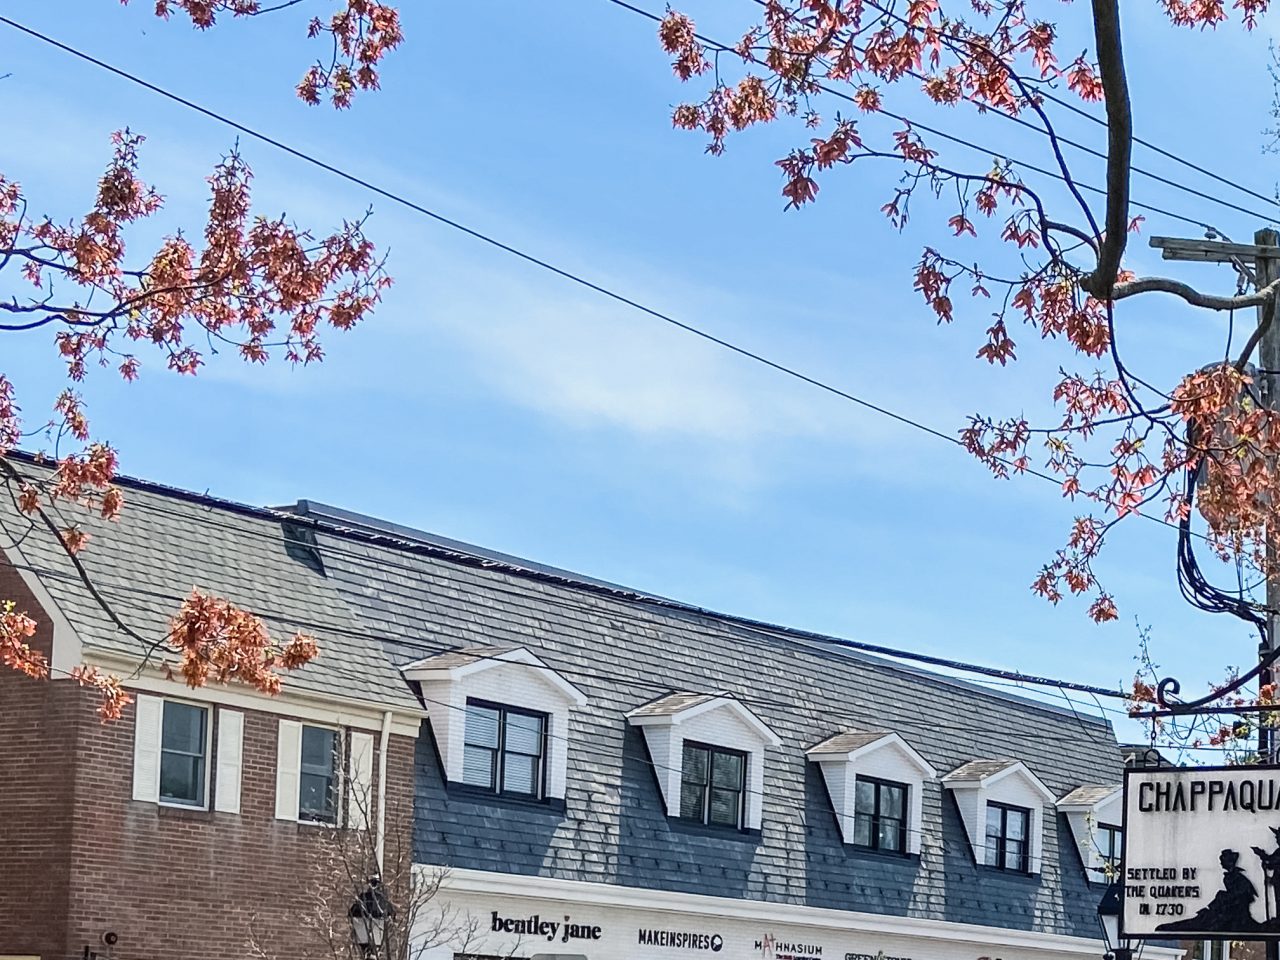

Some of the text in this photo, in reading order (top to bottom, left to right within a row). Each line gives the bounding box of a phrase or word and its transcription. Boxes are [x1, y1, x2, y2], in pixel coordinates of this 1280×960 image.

[1127, 867, 1197, 881] SETTLED BY
[1126, 885, 1200, 899] THE QUAKERS
[1139, 903, 1184, 916] IN 1730
[491, 911, 602, 943] bentley jane
[638, 928, 710, 950] MAKEINSPIRES
